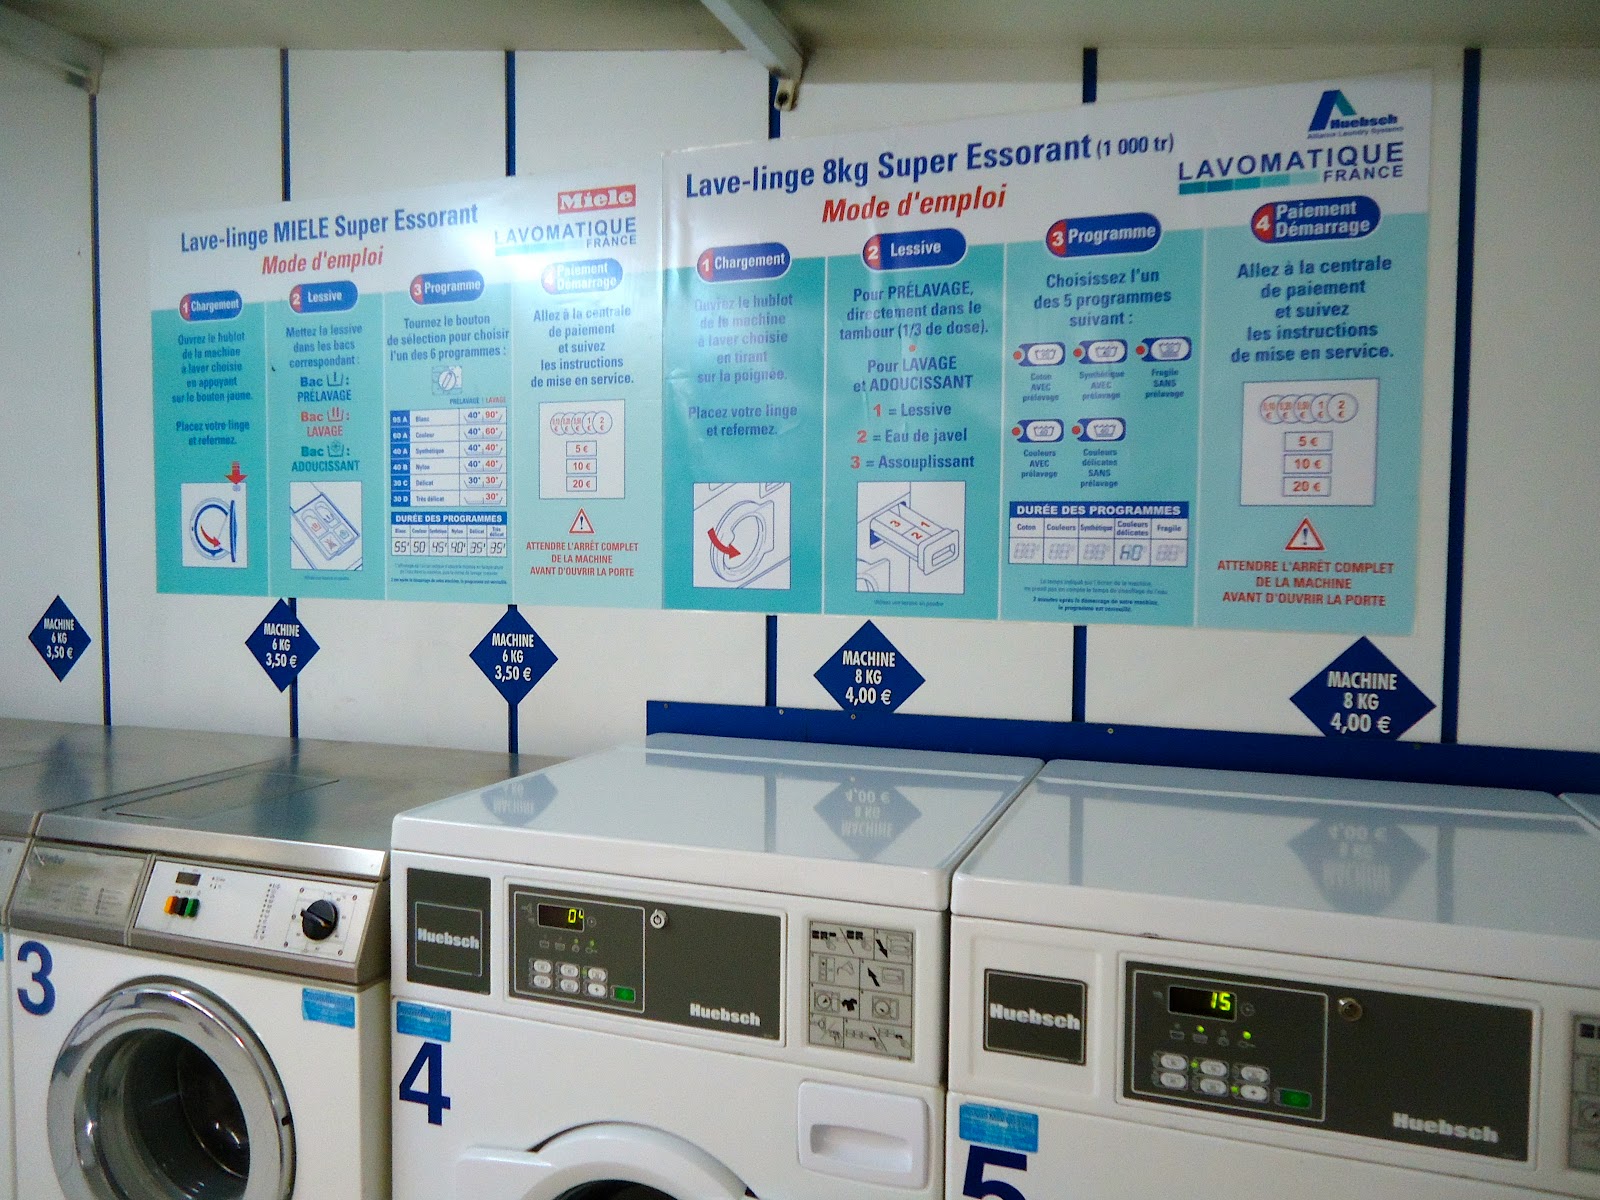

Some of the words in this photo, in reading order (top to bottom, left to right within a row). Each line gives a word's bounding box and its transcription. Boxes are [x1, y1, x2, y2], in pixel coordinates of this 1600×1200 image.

[1330, 114, 1398, 129] Huebsch
[686, 165, 814, 197] Lave-linge
[823, 159, 869, 186] 8kg
[878, 150, 958, 182] Super
[966, 132, 1091, 170] Essorant
[1118, 136, 1148, 154] 000
[1154, 133, 1174, 153] tr)
[1179, 141, 1404, 180] LAVOMATIQUE
[1323, 165, 1404, 183] FRANCE
[559, 191, 636, 211] Miele
[822, 196, 890, 223] Mode
[897, 184, 1007, 217] d'emploi
[1256, 216, 1271, 232] 4
[1276, 201, 1357, 220] Paiement
[181, 227, 268, 252] Lave-linge
[274, 217, 329, 243] MIELE
[335, 215, 389, 241] Super
[394, 204, 478, 231] Essorant
[495, 217, 636, 244] LAVOMATIQUE
[1052, 231, 1063, 246] 3
[1068, 225, 1156, 245] Programme
[1276, 218, 1370, 238] Démarrage
[586, 235, 636, 248] FRANCE
[868, 245, 879, 260] 2
[890, 240, 942, 257] Lessive
[262, 254, 307, 275] Mode
[312, 245, 384, 273] d'emploi
[702, 259, 711, 271] 1
[714, 252, 785, 271] Chargement
[1237, 262, 1279, 278] Allez
[1284, 260, 1293, 275] à
[1300, 259, 1314, 274] la
[1320, 255, 1392, 273] centrale
[557, 263, 608, 277] Paiement
[1047, 271, 1126, 288] Choisissez
[1131, 268, 1159, 282] l'un
[414, 284, 421, 296] 3
[424, 280, 481, 295] Programme
[853, 288, 884, 302] Pour
[888, 281, 974, 300] PRÉLAVAGE,
[1261, 283, 1281, 298] de
[1287, 280, 1366, 300] paiement
[292, 294, 300, 304] 2
[308, 290, 342, 303] Lessive
[1034, 295, 1060, 309] des
[1064, 293, 1072, 307] 5
[1076, 290, 1172, 310] programmes
[183, 303, 188, 313] 1
[191, 299, 239, 312] Chargement
[847, 304, 927, 321] directement
[931, 302, 964, 316] dans
[969, 300, 982, 314] le
[1275, 305, 1291, 318] et
[1296, 302, 1350, 317] suivez
[1070, 312, 1125, 327] suivant
[840, 325, 894, 340] tambour
[898, 322, 922, 339] (1/3
[926, 322, 942, 336] de
[947, 319, 988, 335] dose).
[1247, 327, 1271, 341] les
[1277, 322, 1378, 340] instructions
[1231, 348, 1250, 363] de
[1255, 347, 1295, 362] mise
[1301, 348, 1320, 361] en
[1325, 343, 1394, 359] service.
[867, 359, 898, 373] Pour
[902, 356, 957, 372] LAVAGE
[853, 380, 866, 392] et
[870, 374, 973, 392] ADOUCISSANT
[1031, 383, 1051, 391] AVEC
[1153, 379, 1176, 387] SANS
[298, 389, 352, 402] PRÉLAVAGE
[873, 404, 881, 417] 1
[901, 403, 951, 417] Lessive
[307, 426, 343, 437] LAVAGE
[857, 430, 867, 443] 2
[885, 430, 909, 443] Eau
[913, 429, 929, 443] de
[933, 428, 968, 445] javel
[292, 460, 360, 472] ADOUCISSANT
[851, 455, 861, 469] 3
[878, 454, 975, 471] Assouplissant
[395, 513, 423, 523] DURÉE
[425, 514, 442, 523] DES
[445, 514, 503, 524] PROGRAMMES
[1017, 504, 1058, 515] DURÉE
[1061, 505, 1086, 515] DES
[1090, 505, 1181, 516] PROGRAMMES
[1157, 524, 1181, 533] Fragile
[526, 541, 566, 551] ATTENDRE
[568, 540, 599, 551] L'ARRÊT
[601, 542, 638, 551] COMPLET
[552, 555, 561, 563] DE
[564, 555, 573, 563] LA
[576, 555, 612, 564] MACHINE
[1217, 560, 1278, 572] ATTENDRE
[1282, 559, 1331, 573] L'ARRÊT
[1335, 562, 1395, 574] COMPLET
[530, 566, 556, 575] AVANT
[558, 567, 595, 576] D'OUVRIR
[597, 568, 606, 576] LA
[608, 568, 634, 576] PORTE
[1256, 576, 1272, 587] DE
[1275, 577, 1290, 588] LA
[1294, 577, 1352, 589] MACHINE
[1222, 592, 1261, 603] AVANT
[1266, 592, 1324, 604] D'OUVRIR
[1327, 594, 1342, 605] LA
[1346, 595, 1387, 606] PORTE
[44, 618, 75, 631] MACHINE
[263, 622, 300, 638] MACHINE
[51, 632, 56, 643] 6
[57, 632, 67, 644] KG
[272, 638, 278, 650] 6
[278, 638, 291, 651] KG
[492, 633, 534, 647] MACHINE
[46, 645, 65, 660] 3,50
[66, 647, 73, 660] €
[266, 652, 287, 669] 3,50
[289, 654, 297, 669] €
[502, 649, 508, 662] 6
[510, 650, 524, 663] KG
[842, 650, 896, 667] MACHINE
[495, 665, 520, 682] 3,50
[523, 667, 532, 681] €
[855, 669, 862, 684] 8
[866, 669, 882, 685] KG
[1327, 670, 1397, 691] MACHINE
[845, 686, 877, 706] 4,00
[880, 689, 892, 705] €
[1343, 692, 1354, 709] 8
[1357, 693, 1380, 710] KG
[1330, 712, 1372, 734] 4,00
[1377, 716, 1392, 734] €
[417, 927, 480, 950] Huebsch
[17, 940, 56, 1016] 3
[1209, 991, 1231, 1012] 15
[690, 1002, 761, 1027] Huebsch
[989, 1002, 1081, 1031] Huebsch
[399, 1041, 451, 1126] 4
[1392, 1111, 1499, 1143] Huebsch
[962, 1144, 1028, 1200] 5
